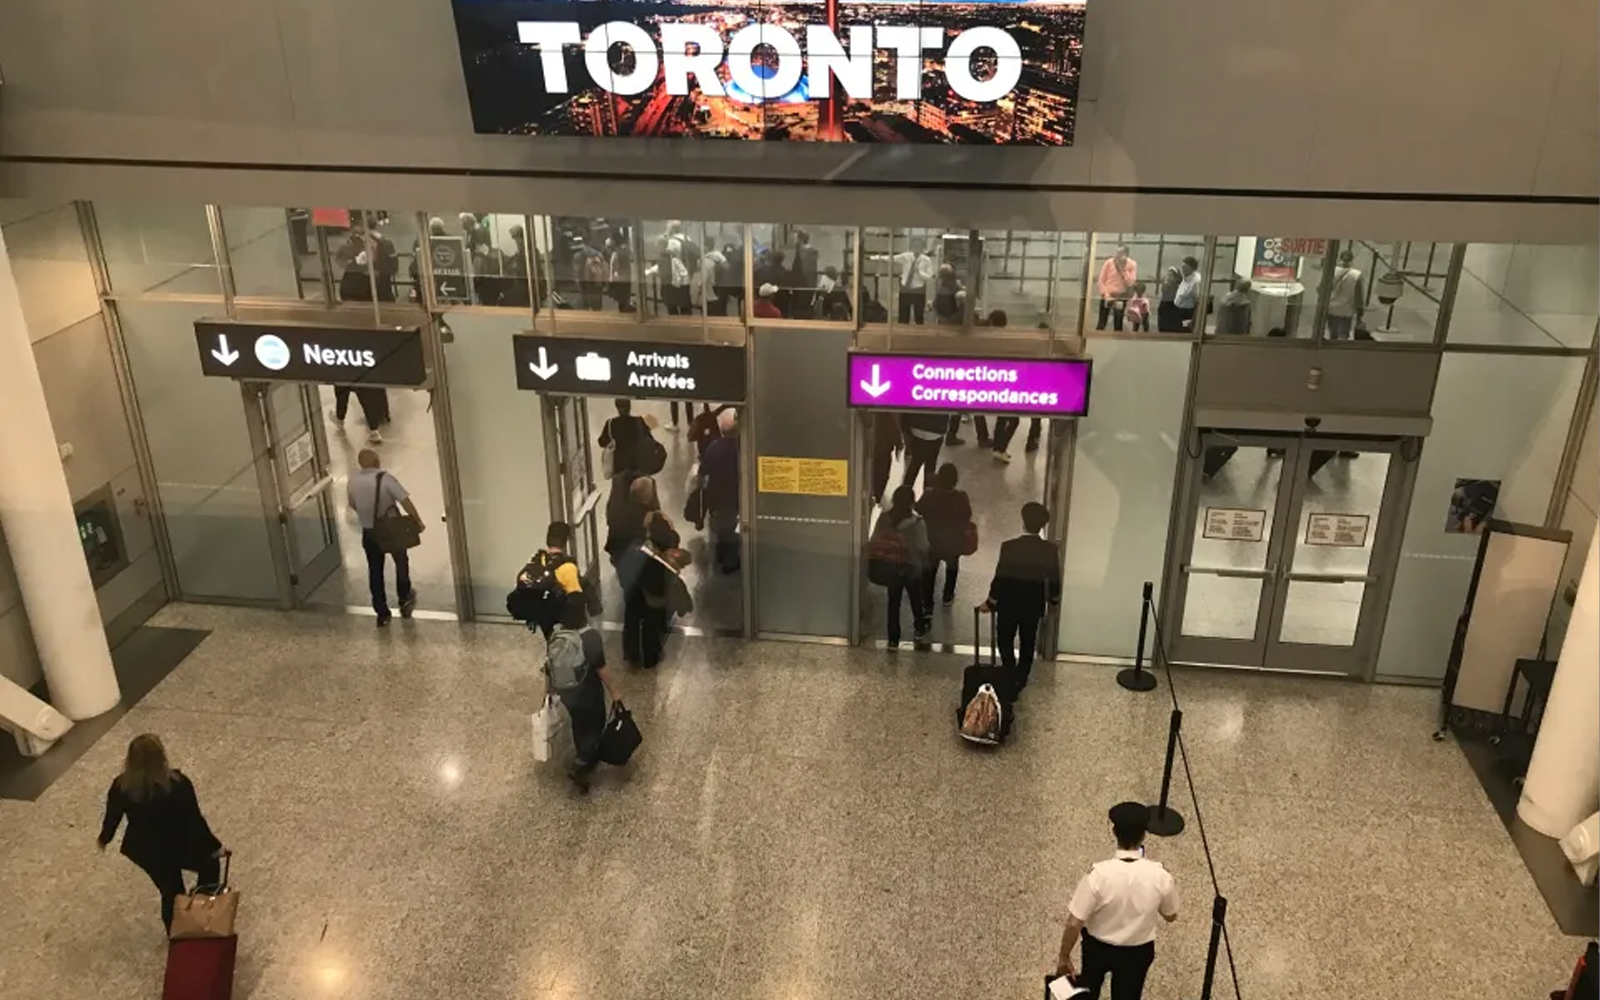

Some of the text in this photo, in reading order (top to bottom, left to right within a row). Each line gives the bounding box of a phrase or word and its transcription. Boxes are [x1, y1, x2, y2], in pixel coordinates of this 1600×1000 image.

[516, 20, 1023, 103] TORONTO
[302, 343, 376, 367] Nexus
[626, 351, 690, 369] Arrivals
[628, 372, 696, 390] Arrivées
[911, 363, 1018, 382] Connections
[911, 385, 1059, 406] Correspondances
